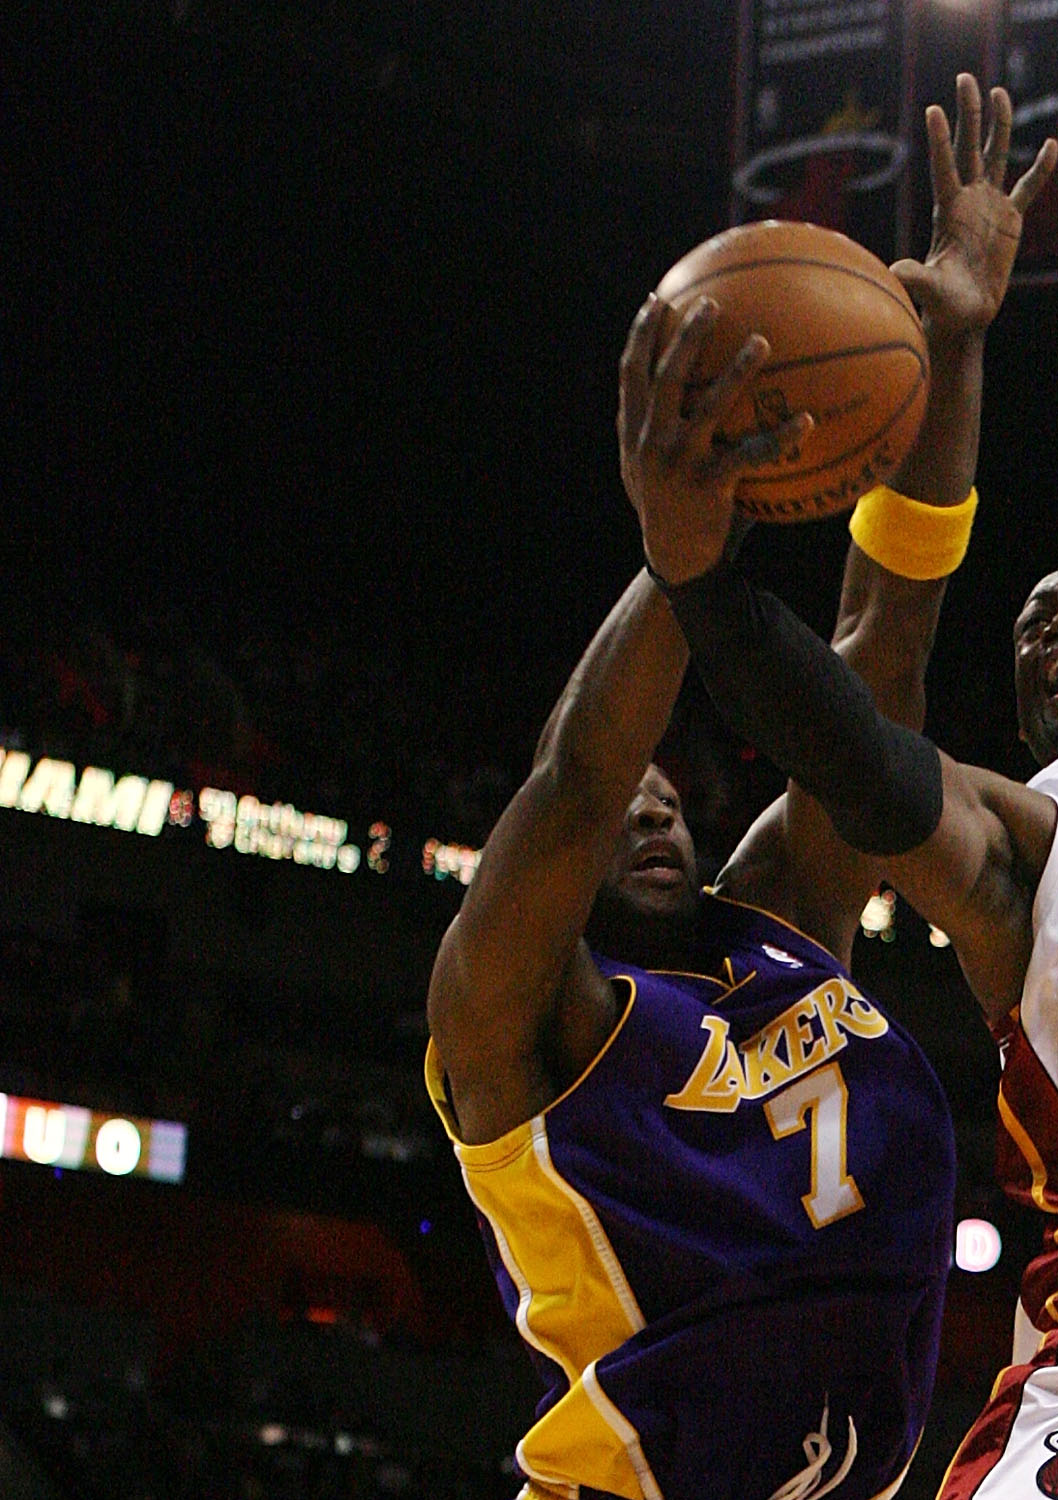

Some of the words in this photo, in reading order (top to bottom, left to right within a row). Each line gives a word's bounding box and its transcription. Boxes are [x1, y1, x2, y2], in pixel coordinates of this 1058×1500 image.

[0, 746, 173, 836] IAMI
[662, 973, 889, 1114] LAKERS
[763, 1061, 866, 1231] 7
